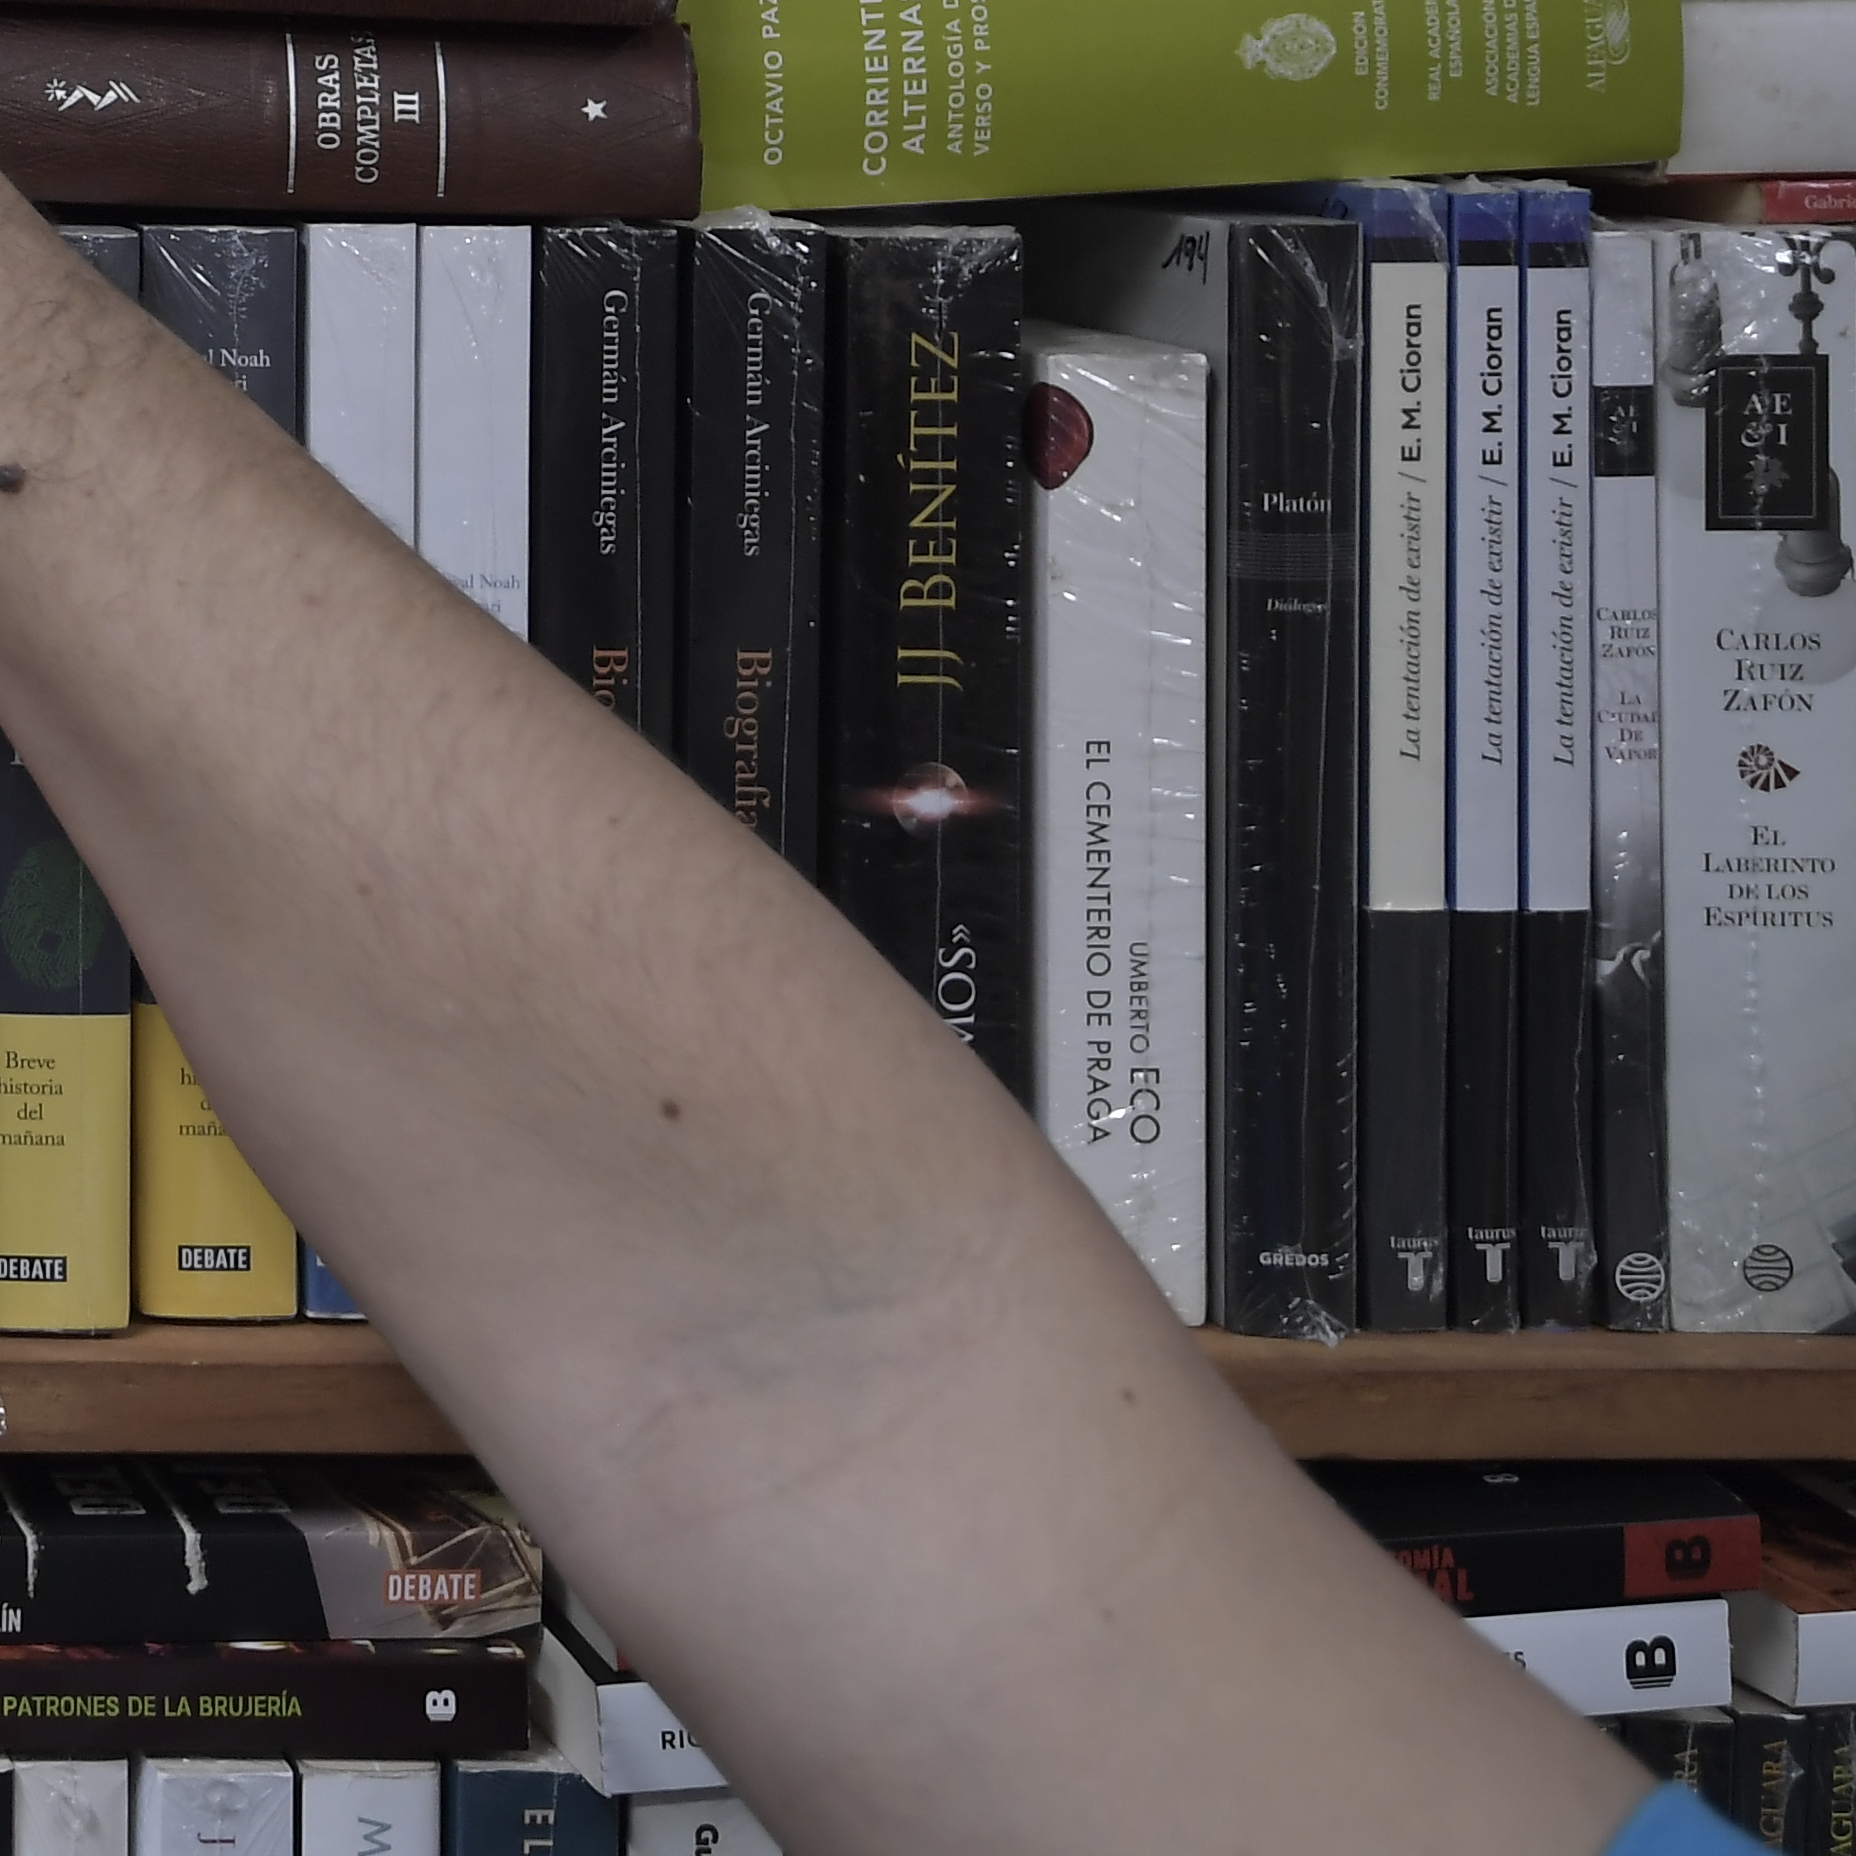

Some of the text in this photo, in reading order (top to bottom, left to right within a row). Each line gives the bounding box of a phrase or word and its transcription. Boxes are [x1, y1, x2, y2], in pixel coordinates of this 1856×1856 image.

[315, 53, 342, 150] OBRAS
[393, 91, 421, 124] III
[764, 50, 784, 166] OCTAVIO
[1400, 303, 1422, 462] E. M. Cioran
[592, 289, 629, 556] Germán Arciniegas
[896, 331, 964, 691] JJ BENÍTEZ
[1716, 628, 1821, 652] CARLOS
[1735, 658, 1804, 682] RUIZ
[1723, 685, 1814, 712] ZAFÓN
[1129, 942, 1160, 1144] UMBERTO ECO
[5, 1050, 56, 1071] Breve
[16, 1103, 44, 1122] del
[388, 1573, 476, 1602] DEBATE
